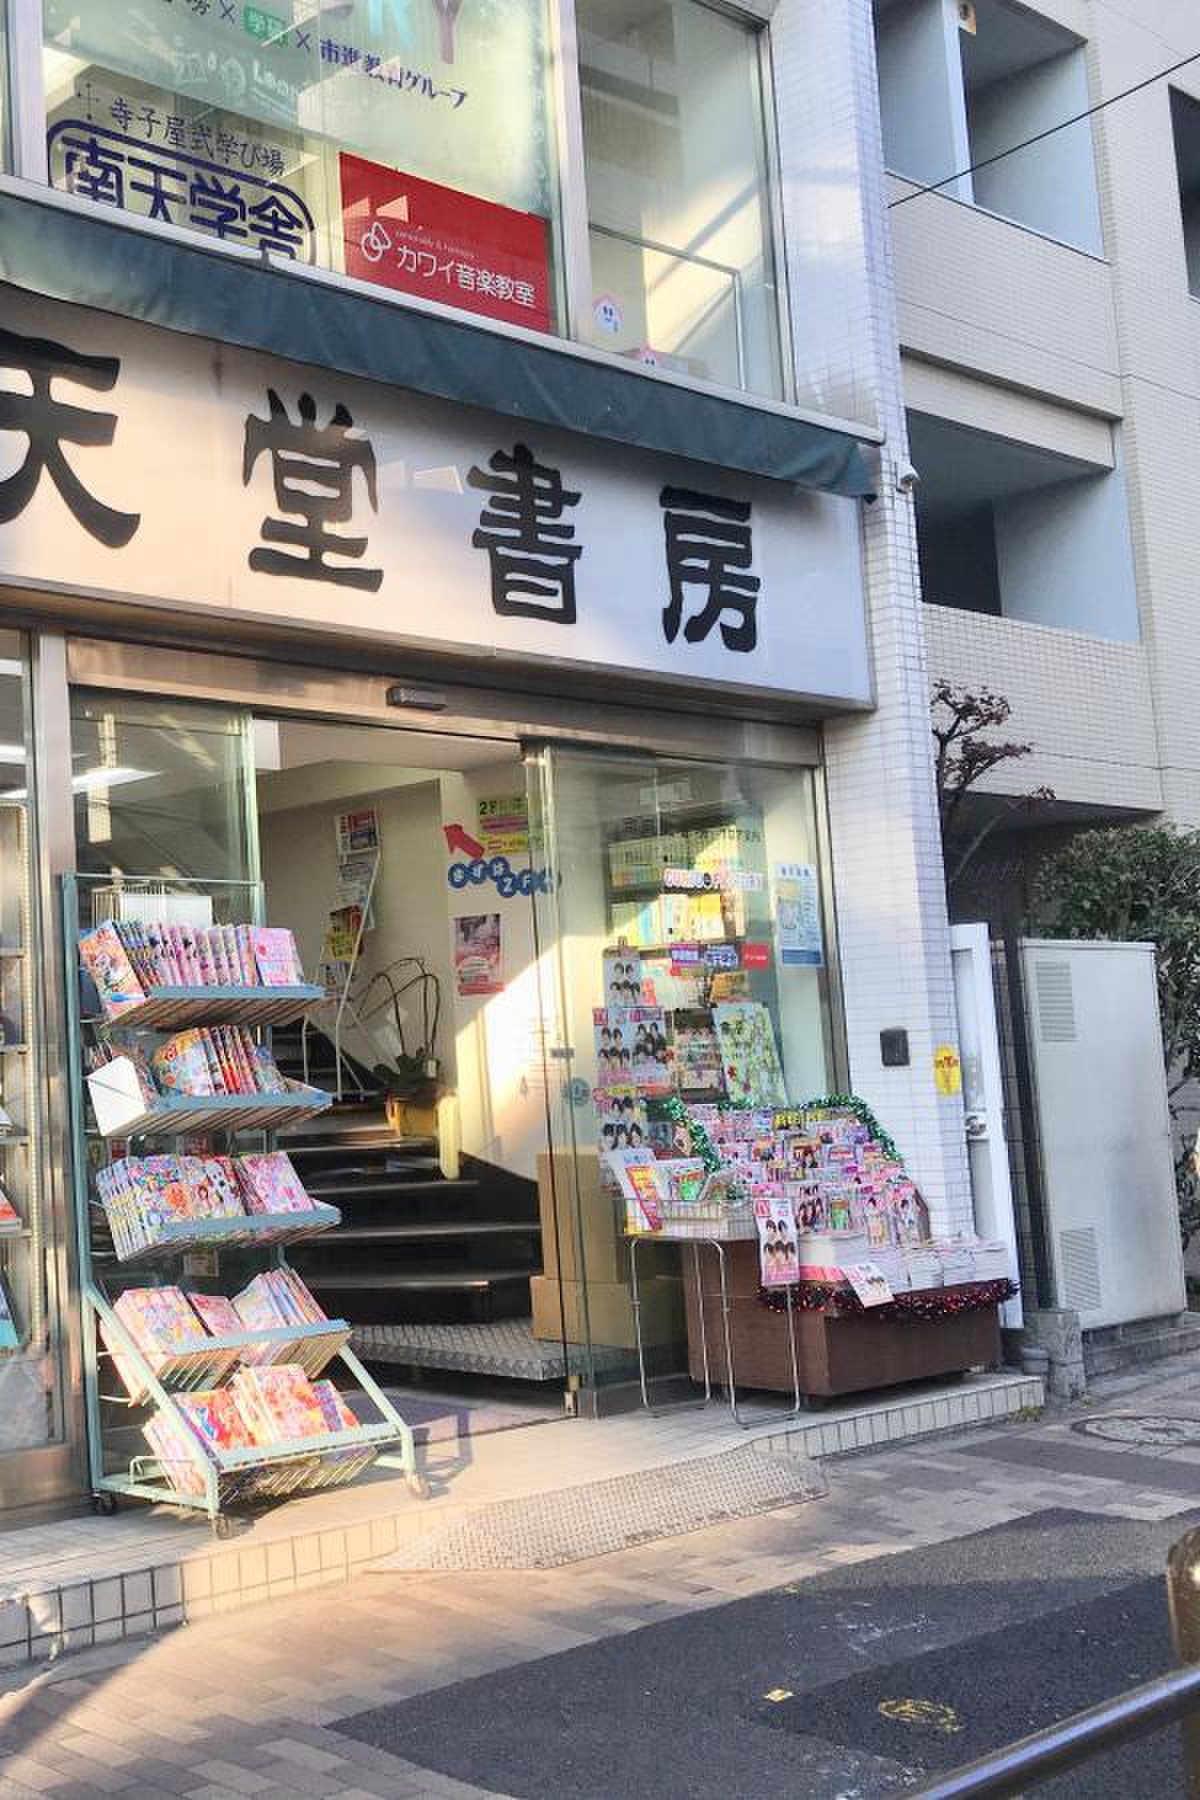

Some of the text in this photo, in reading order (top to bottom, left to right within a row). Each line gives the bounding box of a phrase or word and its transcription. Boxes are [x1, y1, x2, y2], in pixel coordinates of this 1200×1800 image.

[110, 96, 286, 178] 寺子屋式学び場
[60, 134, 304, 262] 南天学舎
[397, 244, 536, 308] カワイ音楽教室
